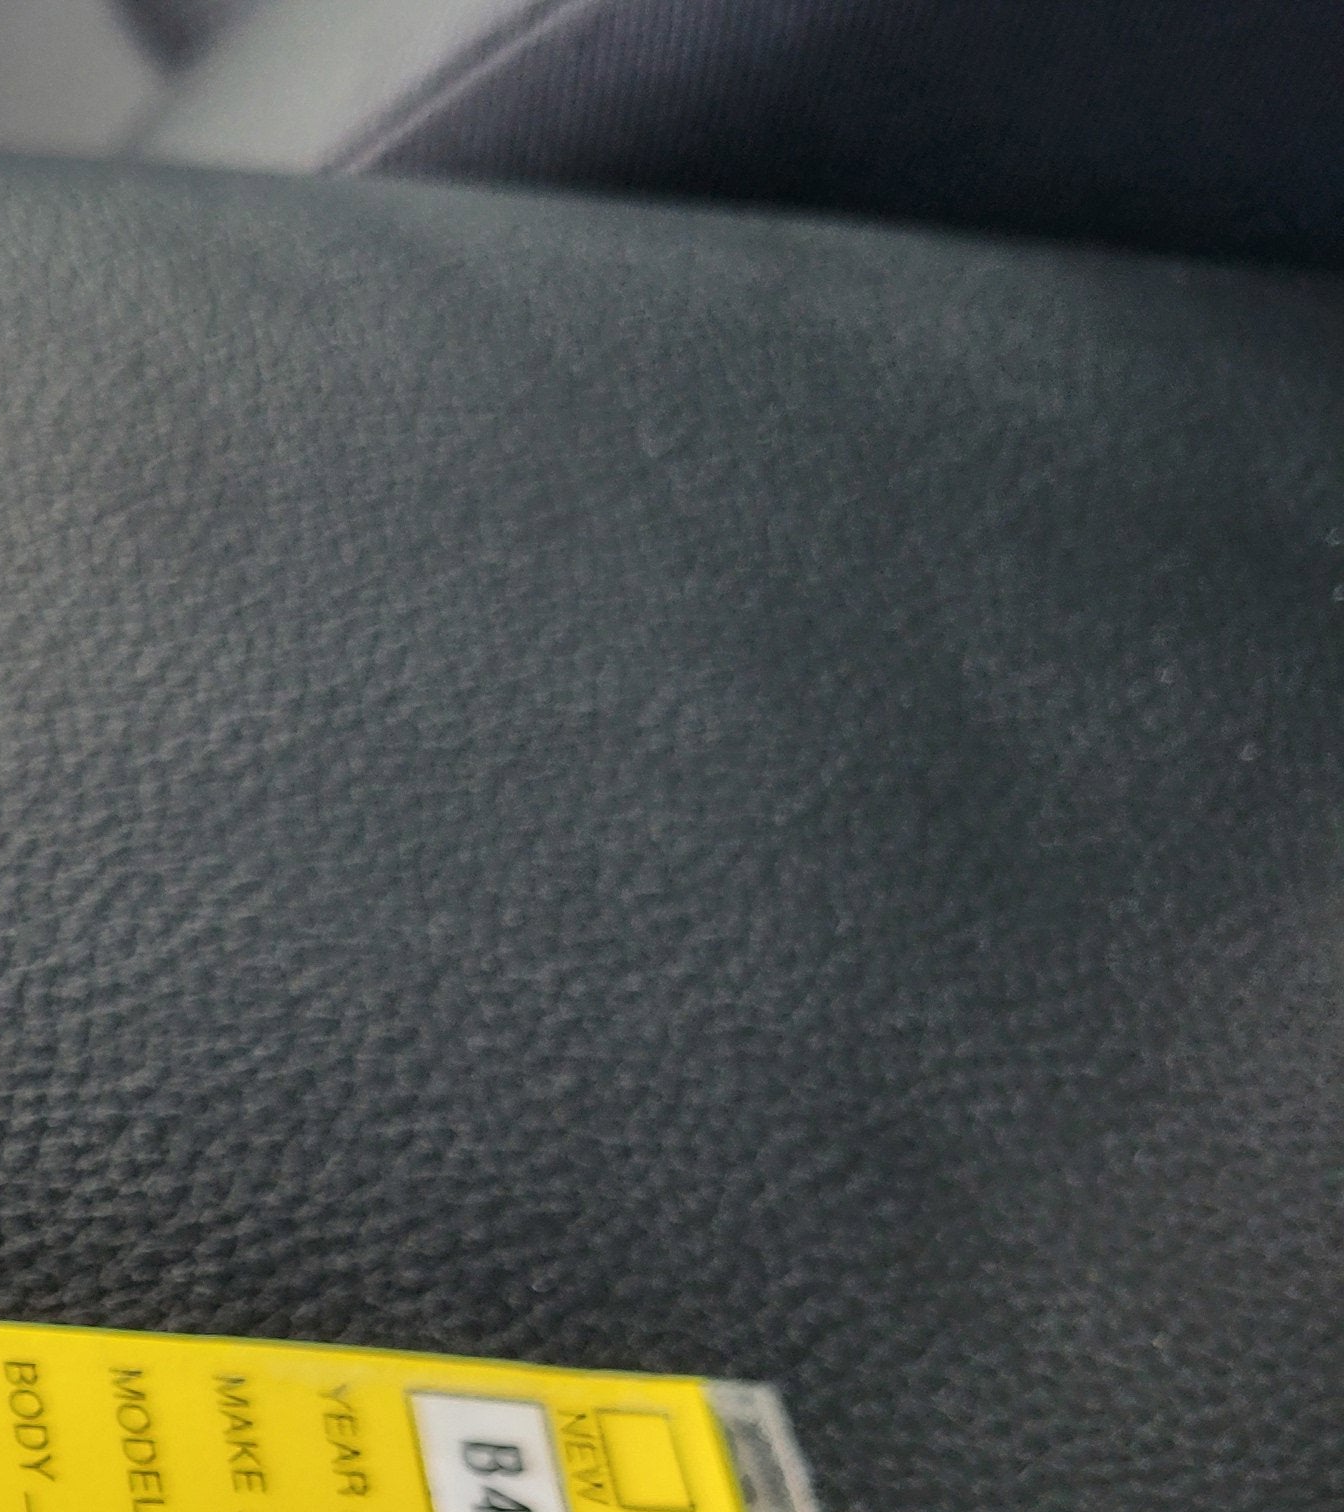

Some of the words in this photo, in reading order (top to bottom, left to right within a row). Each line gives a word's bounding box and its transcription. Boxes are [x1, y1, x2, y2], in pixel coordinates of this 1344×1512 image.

[4, 1360, 56, 1482] BODY
[214, 1375, 268, 1495] MAKE
[320, 1384, 369, 1498] YEAR
[558, 1410, 610, 1507] NEW
